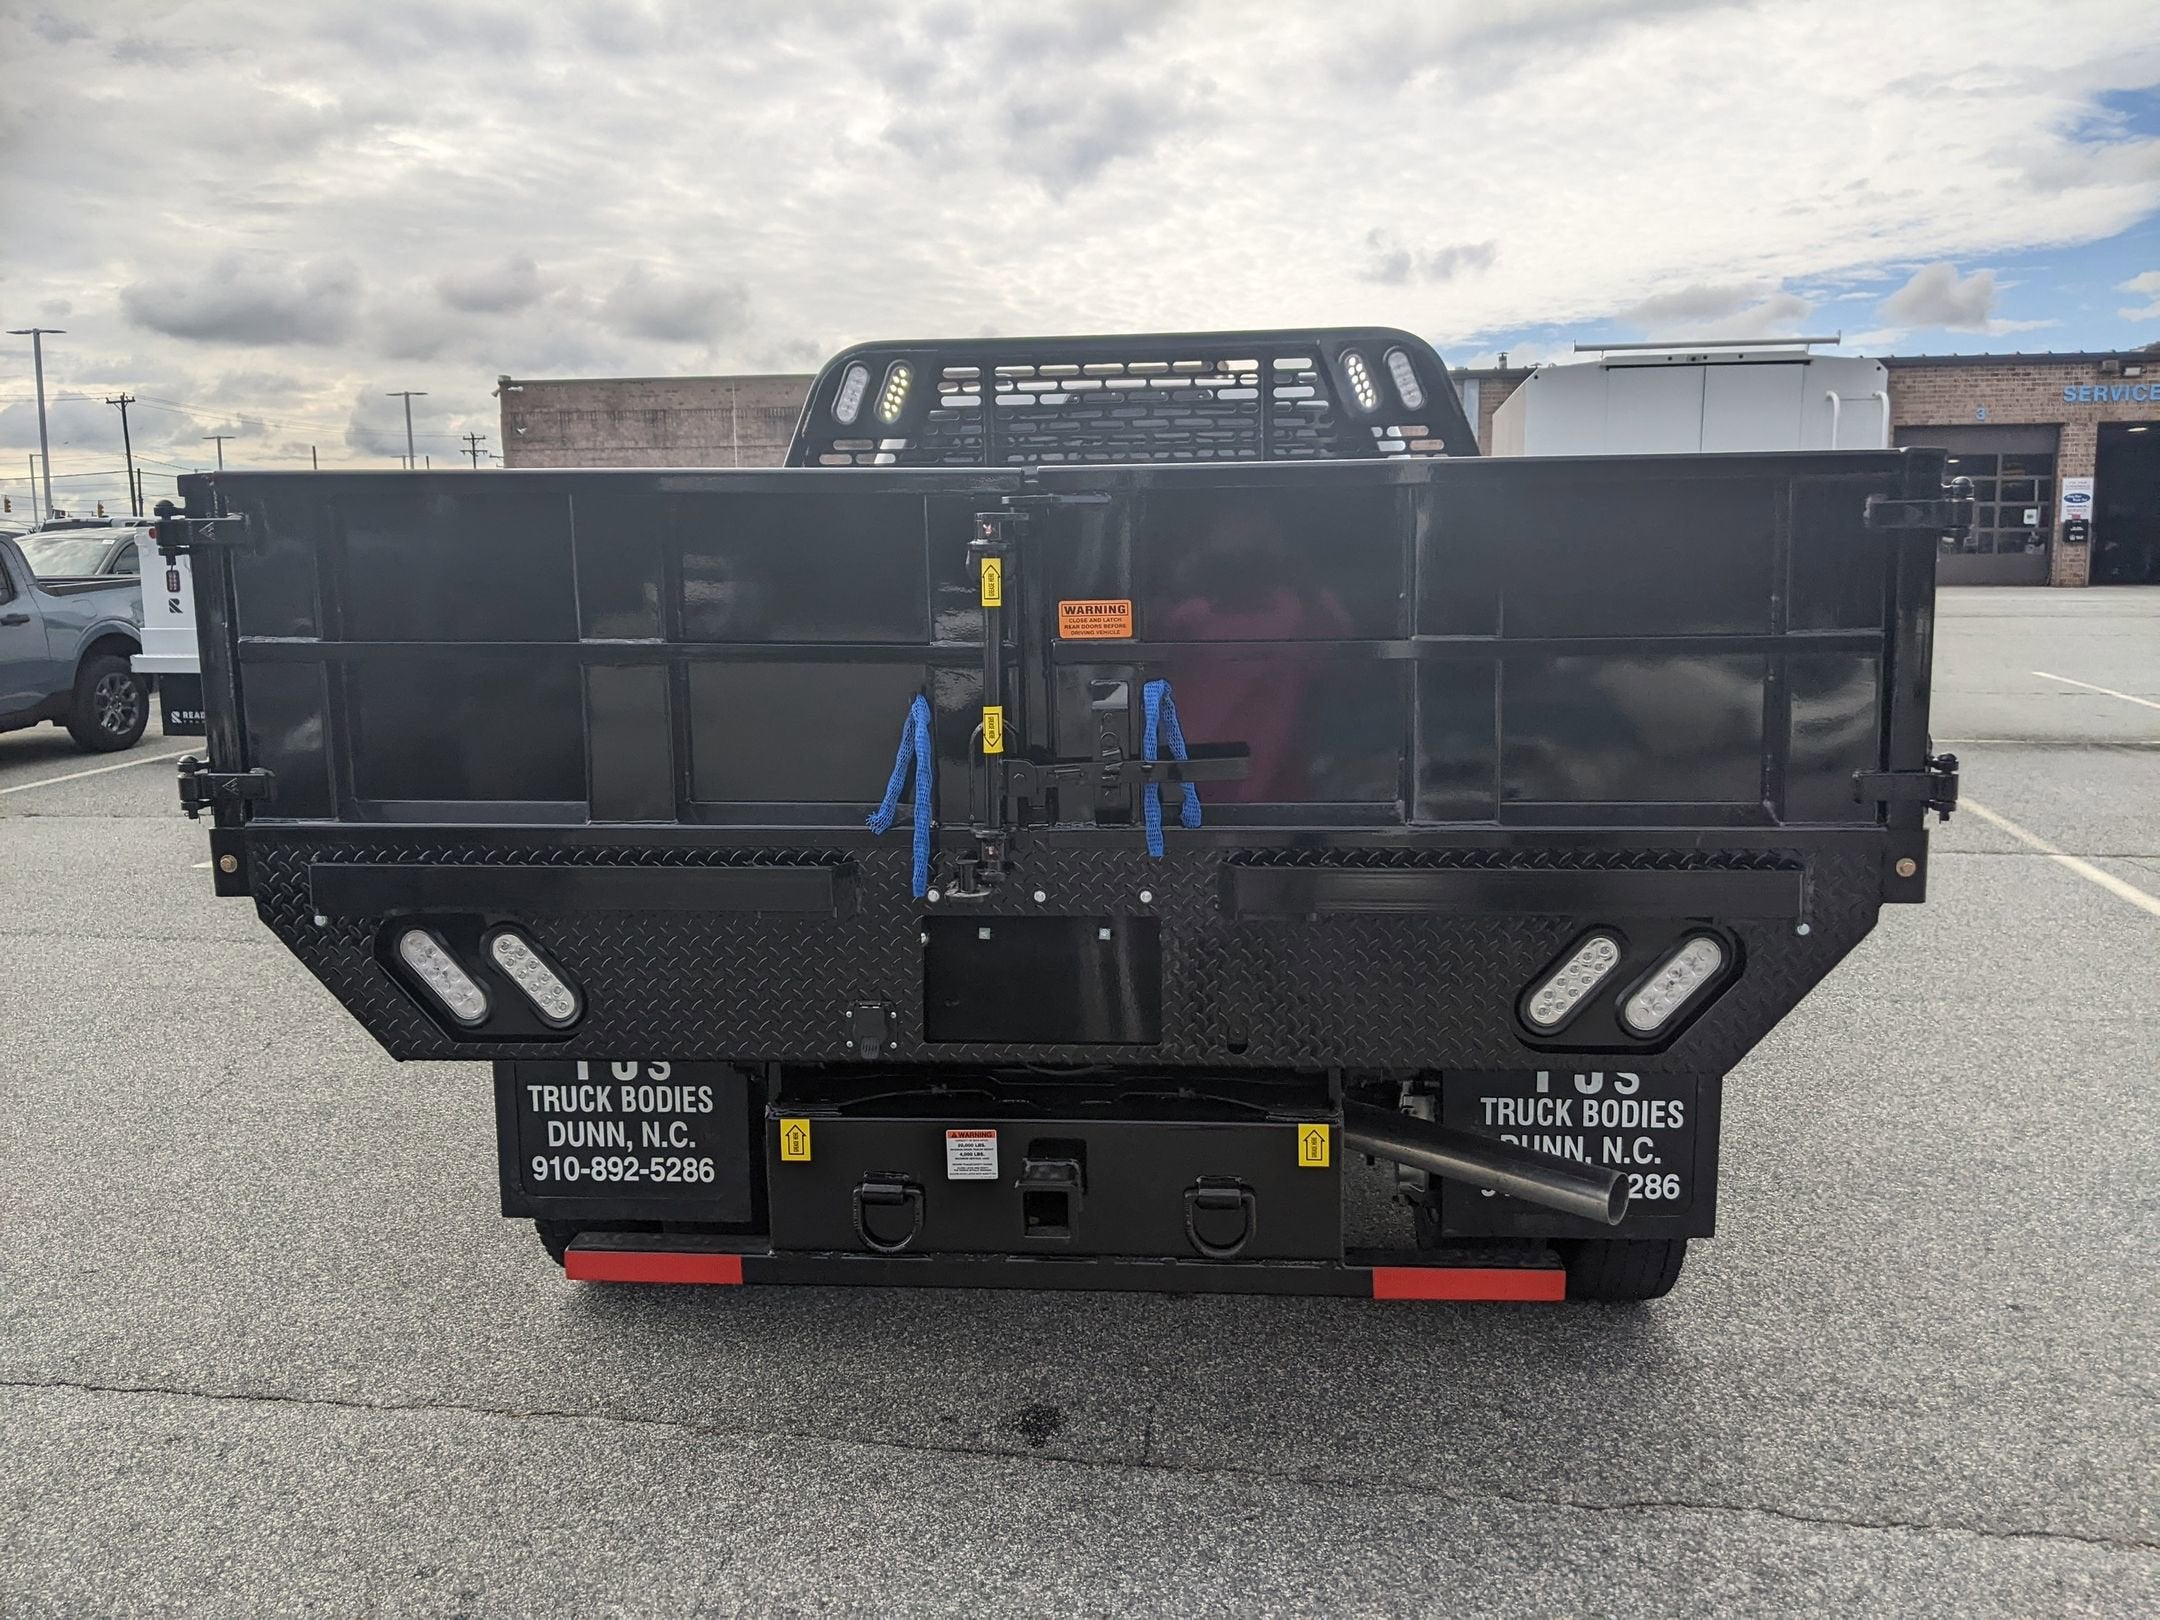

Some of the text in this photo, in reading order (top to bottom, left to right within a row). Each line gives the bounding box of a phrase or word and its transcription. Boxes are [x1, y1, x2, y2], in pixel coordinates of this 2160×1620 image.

[2063, 384, 2160, 402] SERVICE
[1975, 407, 1986, 421] 3
[1063, 604, 1126, 615] WARNING
[527, 1085, 714, 1114] TRUCK BODIES
[1480, 1097, 1684, 1129] TRUCK BODIES
[547, 1120, 696, 1153] DUNN, N.C.
[1602, 1136, 1661, 1165] N.C.
[531, 1156, 716, 1184] 910-892-5286
